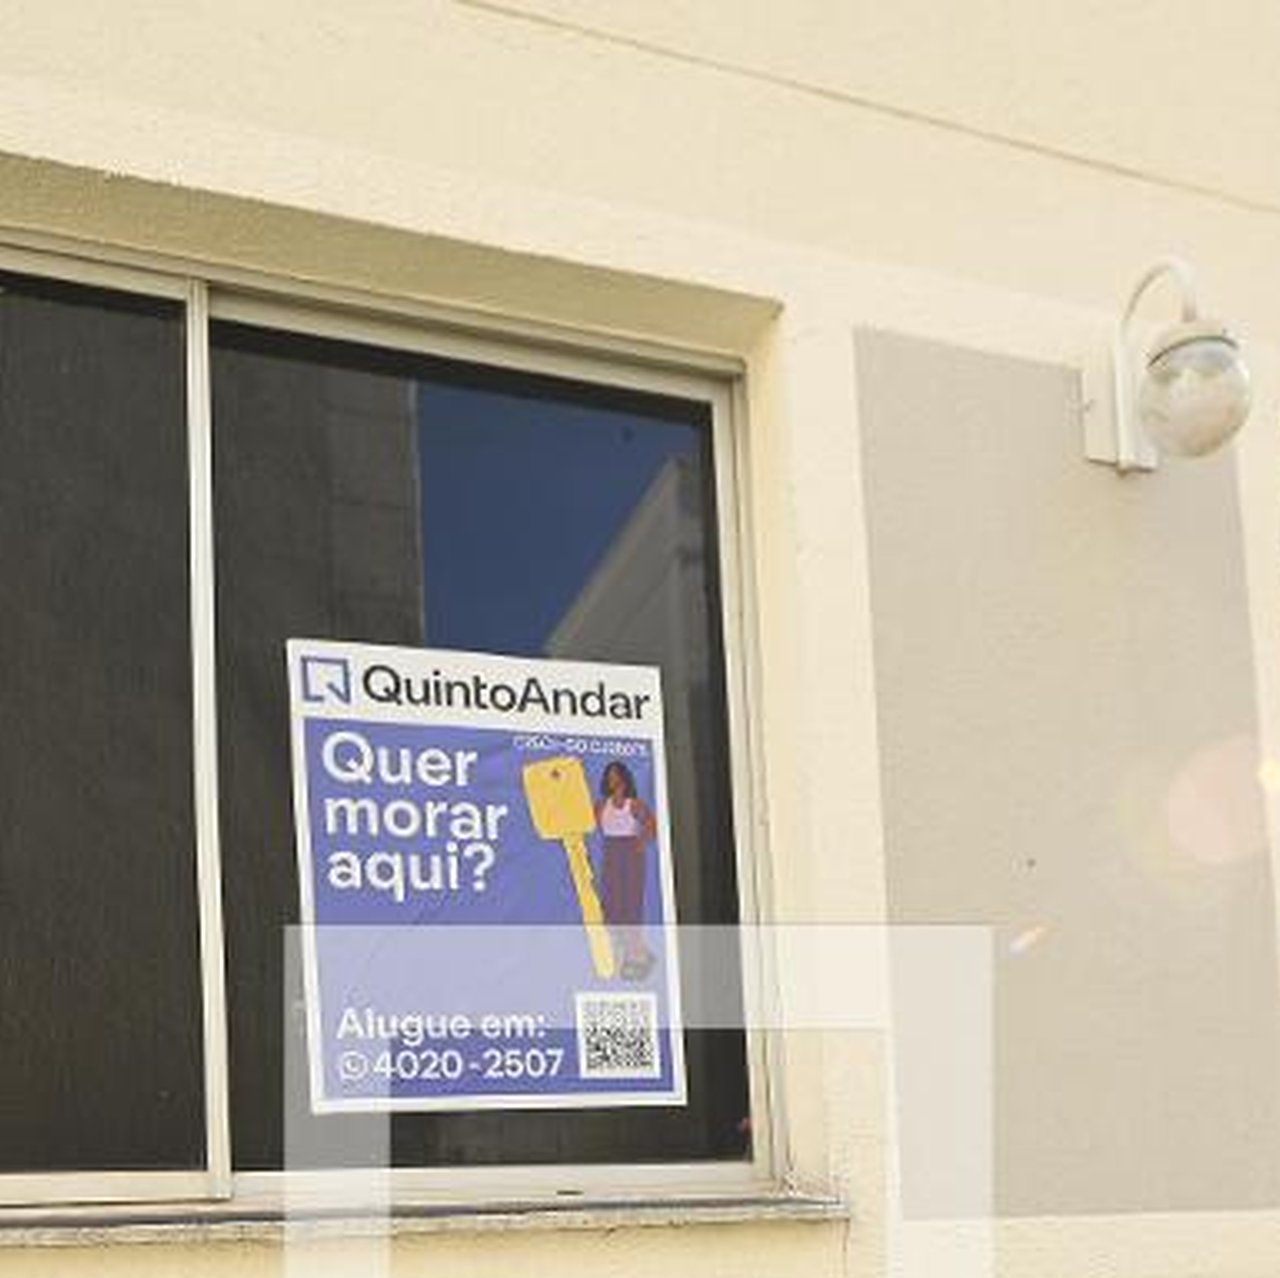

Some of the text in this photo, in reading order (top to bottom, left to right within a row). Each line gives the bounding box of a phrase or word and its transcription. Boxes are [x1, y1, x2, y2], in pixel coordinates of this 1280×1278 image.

[363, 664, 650, 719] QuintoAndar
[323, 731, 479, 787] Quer
[324, 797, 508, 840] morar
[328, 842, 495, 902] aqui?
[336, 1006, 545, 1046] Alugue em:
